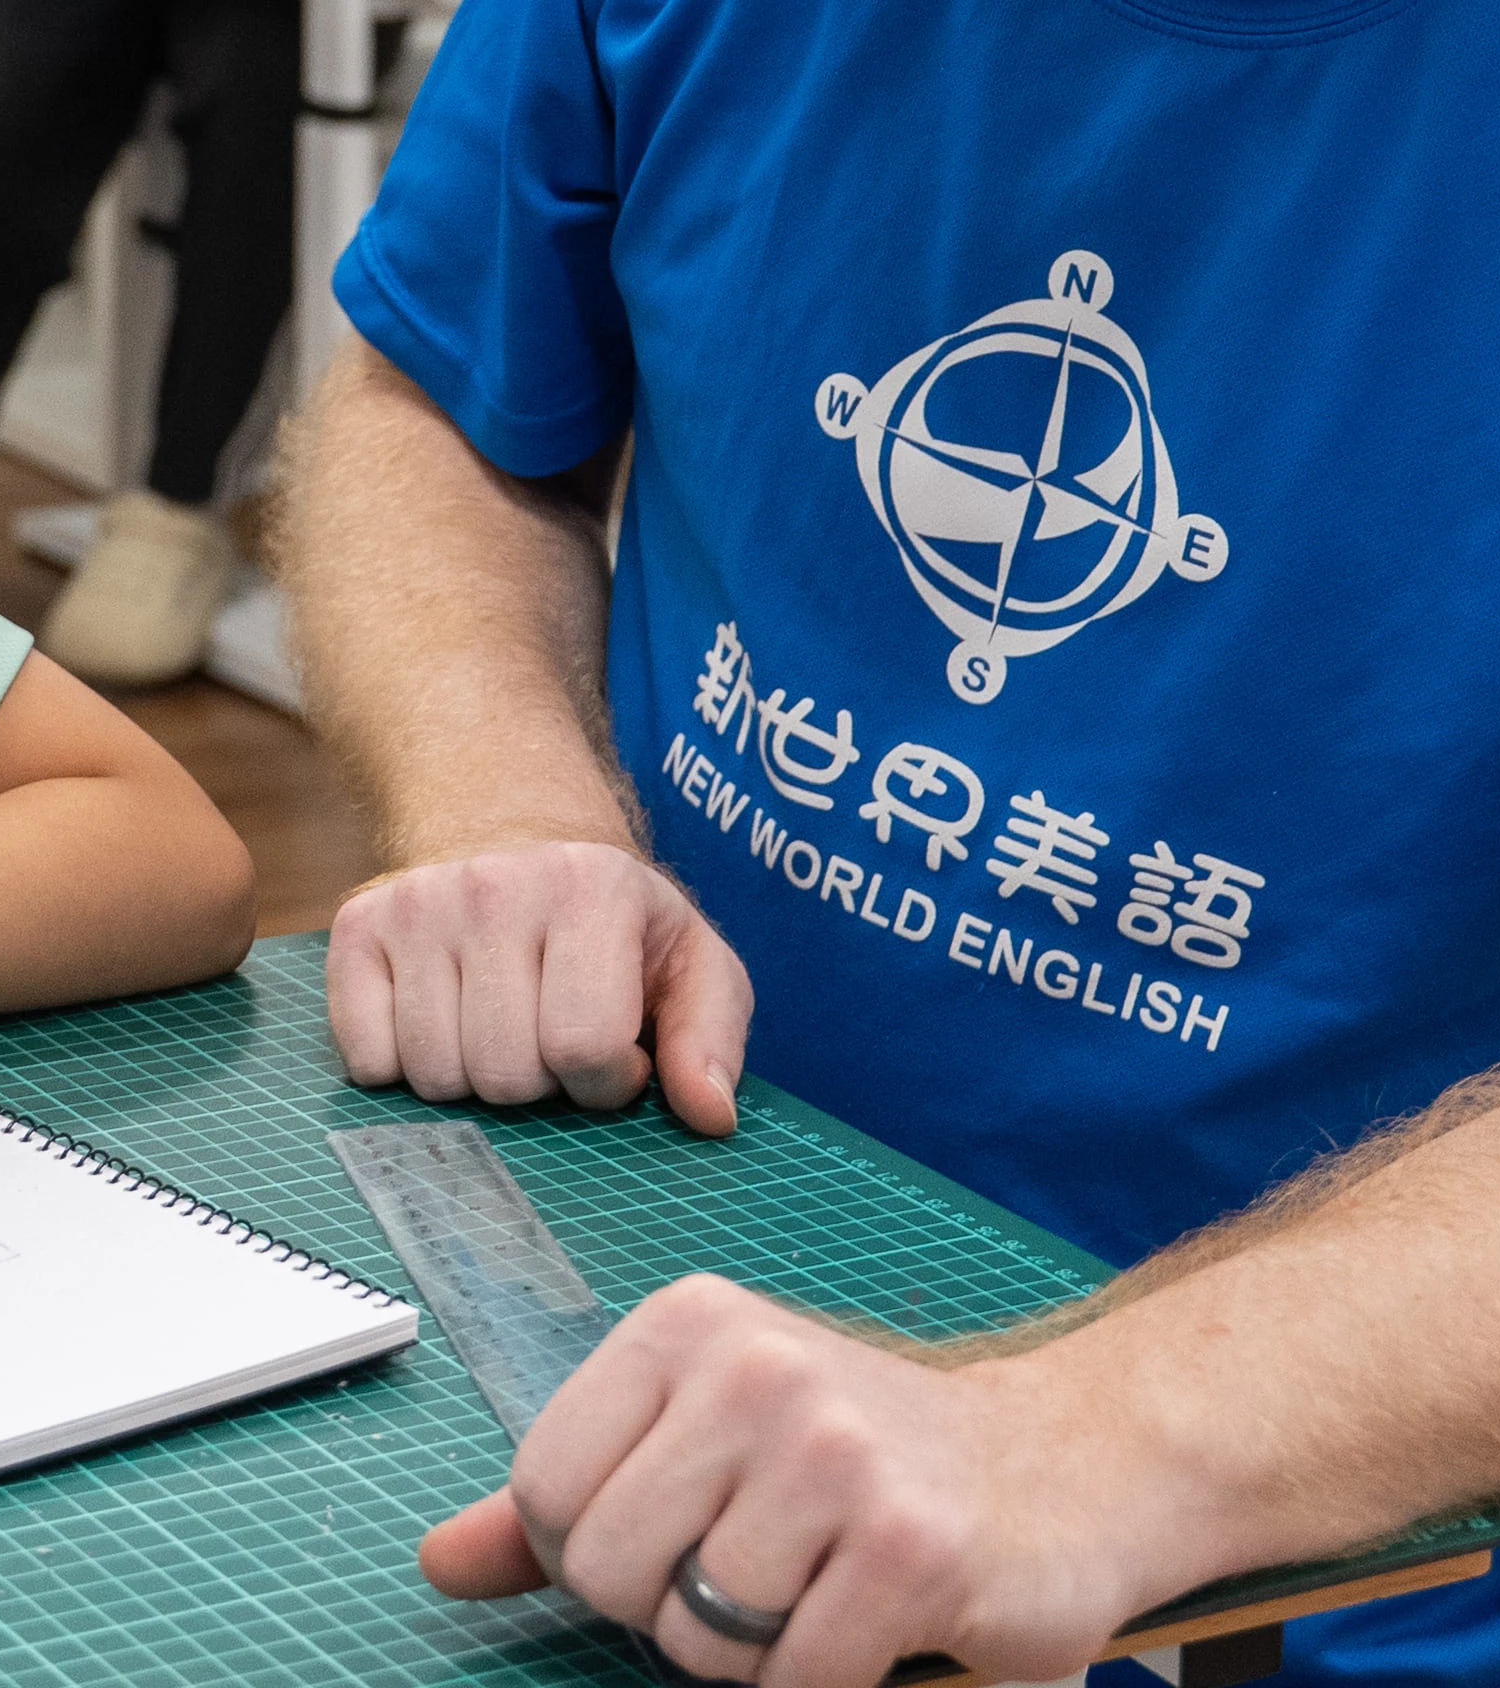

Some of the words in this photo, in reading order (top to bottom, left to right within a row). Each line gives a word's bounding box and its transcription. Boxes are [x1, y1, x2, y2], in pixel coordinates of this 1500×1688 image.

[1063, 263, 1096, 303] N
[826, 386, 861, 422] W
[1181, 527, 1216, 568] E
[961, 657, 992, 692] S
[692, 621, 1266, 969] 新世界美語
[662, 732, 750, 833] NEW
[750, 806, 937, 943] WORLD
[948, 912, 1230, 1052] ENGLISH
